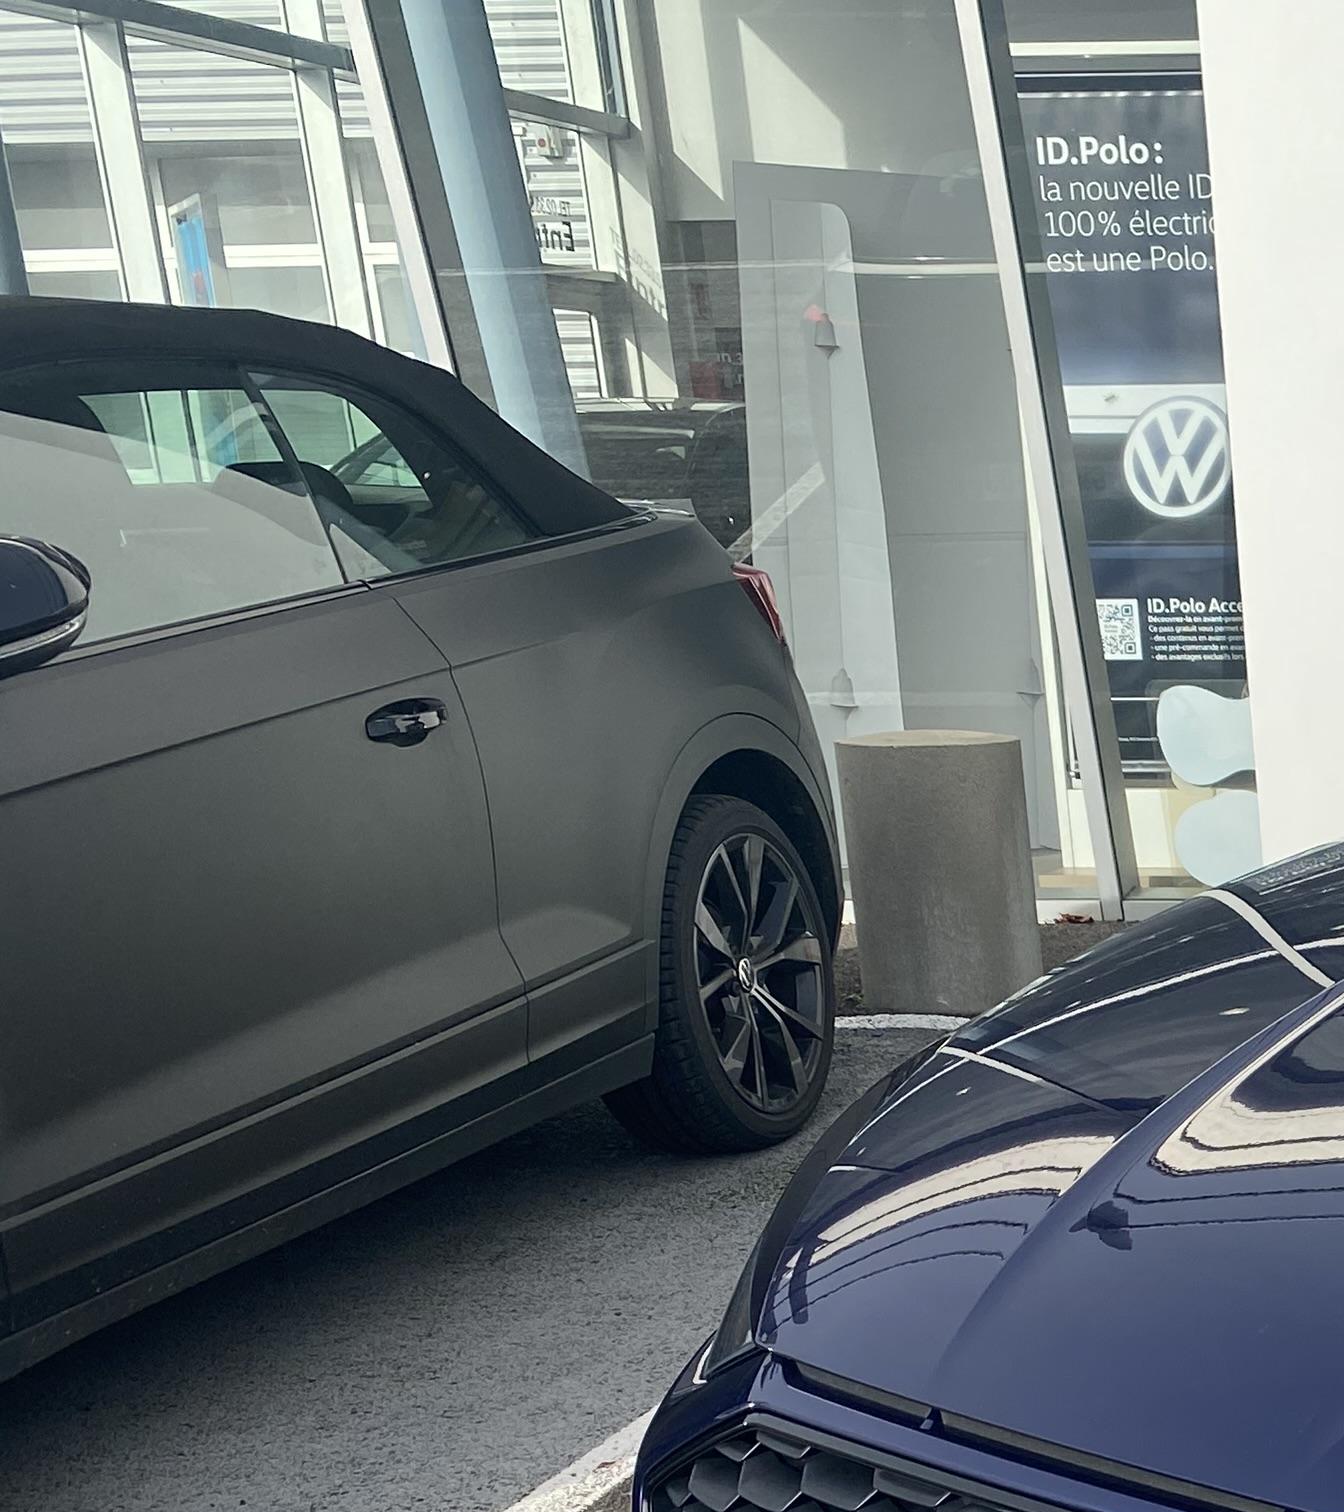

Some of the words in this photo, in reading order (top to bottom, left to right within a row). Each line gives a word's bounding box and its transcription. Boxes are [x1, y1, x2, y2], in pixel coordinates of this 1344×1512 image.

[1039, 174, 1063, 202] la
[1069, 173, 1180, 201] nouvelle
[1046, 248, 1085, 272] est
[1093, 251, 1141, 272] une
[1150, 245, 1215, 271] Polo.
[1147, 597, 1206, 613] ID.Polo
